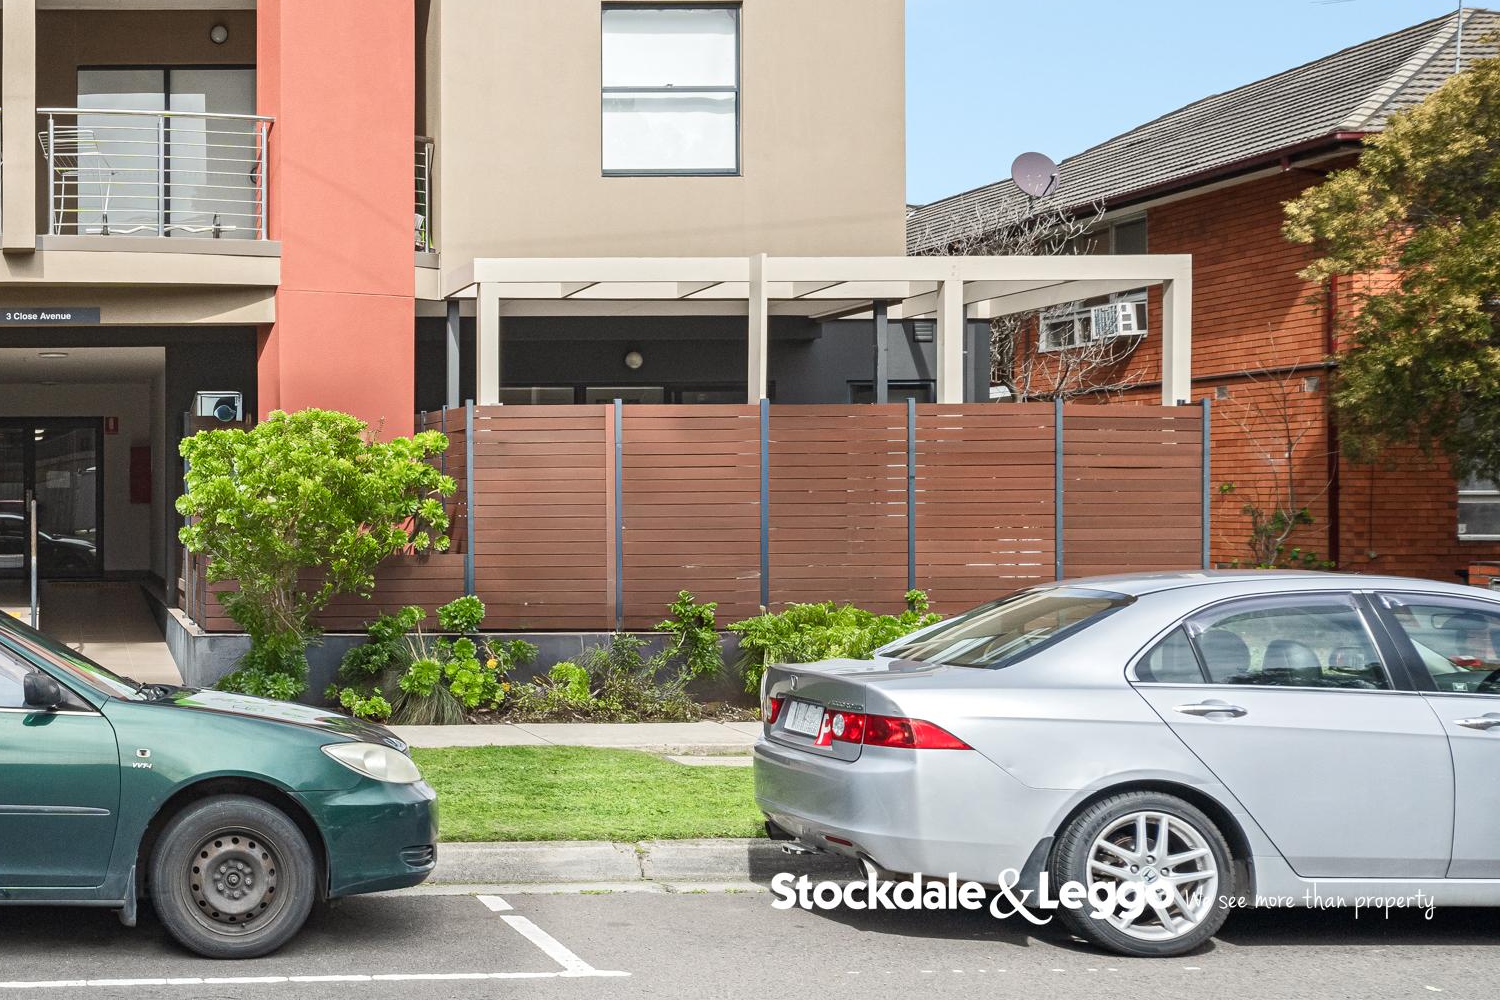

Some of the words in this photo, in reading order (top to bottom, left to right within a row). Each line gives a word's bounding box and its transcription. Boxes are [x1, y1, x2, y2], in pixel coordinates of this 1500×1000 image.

[6, 312, 12, 320] 3
[13, 312, 38, 320] Close
[40, 312, 71, 320] Avenue
